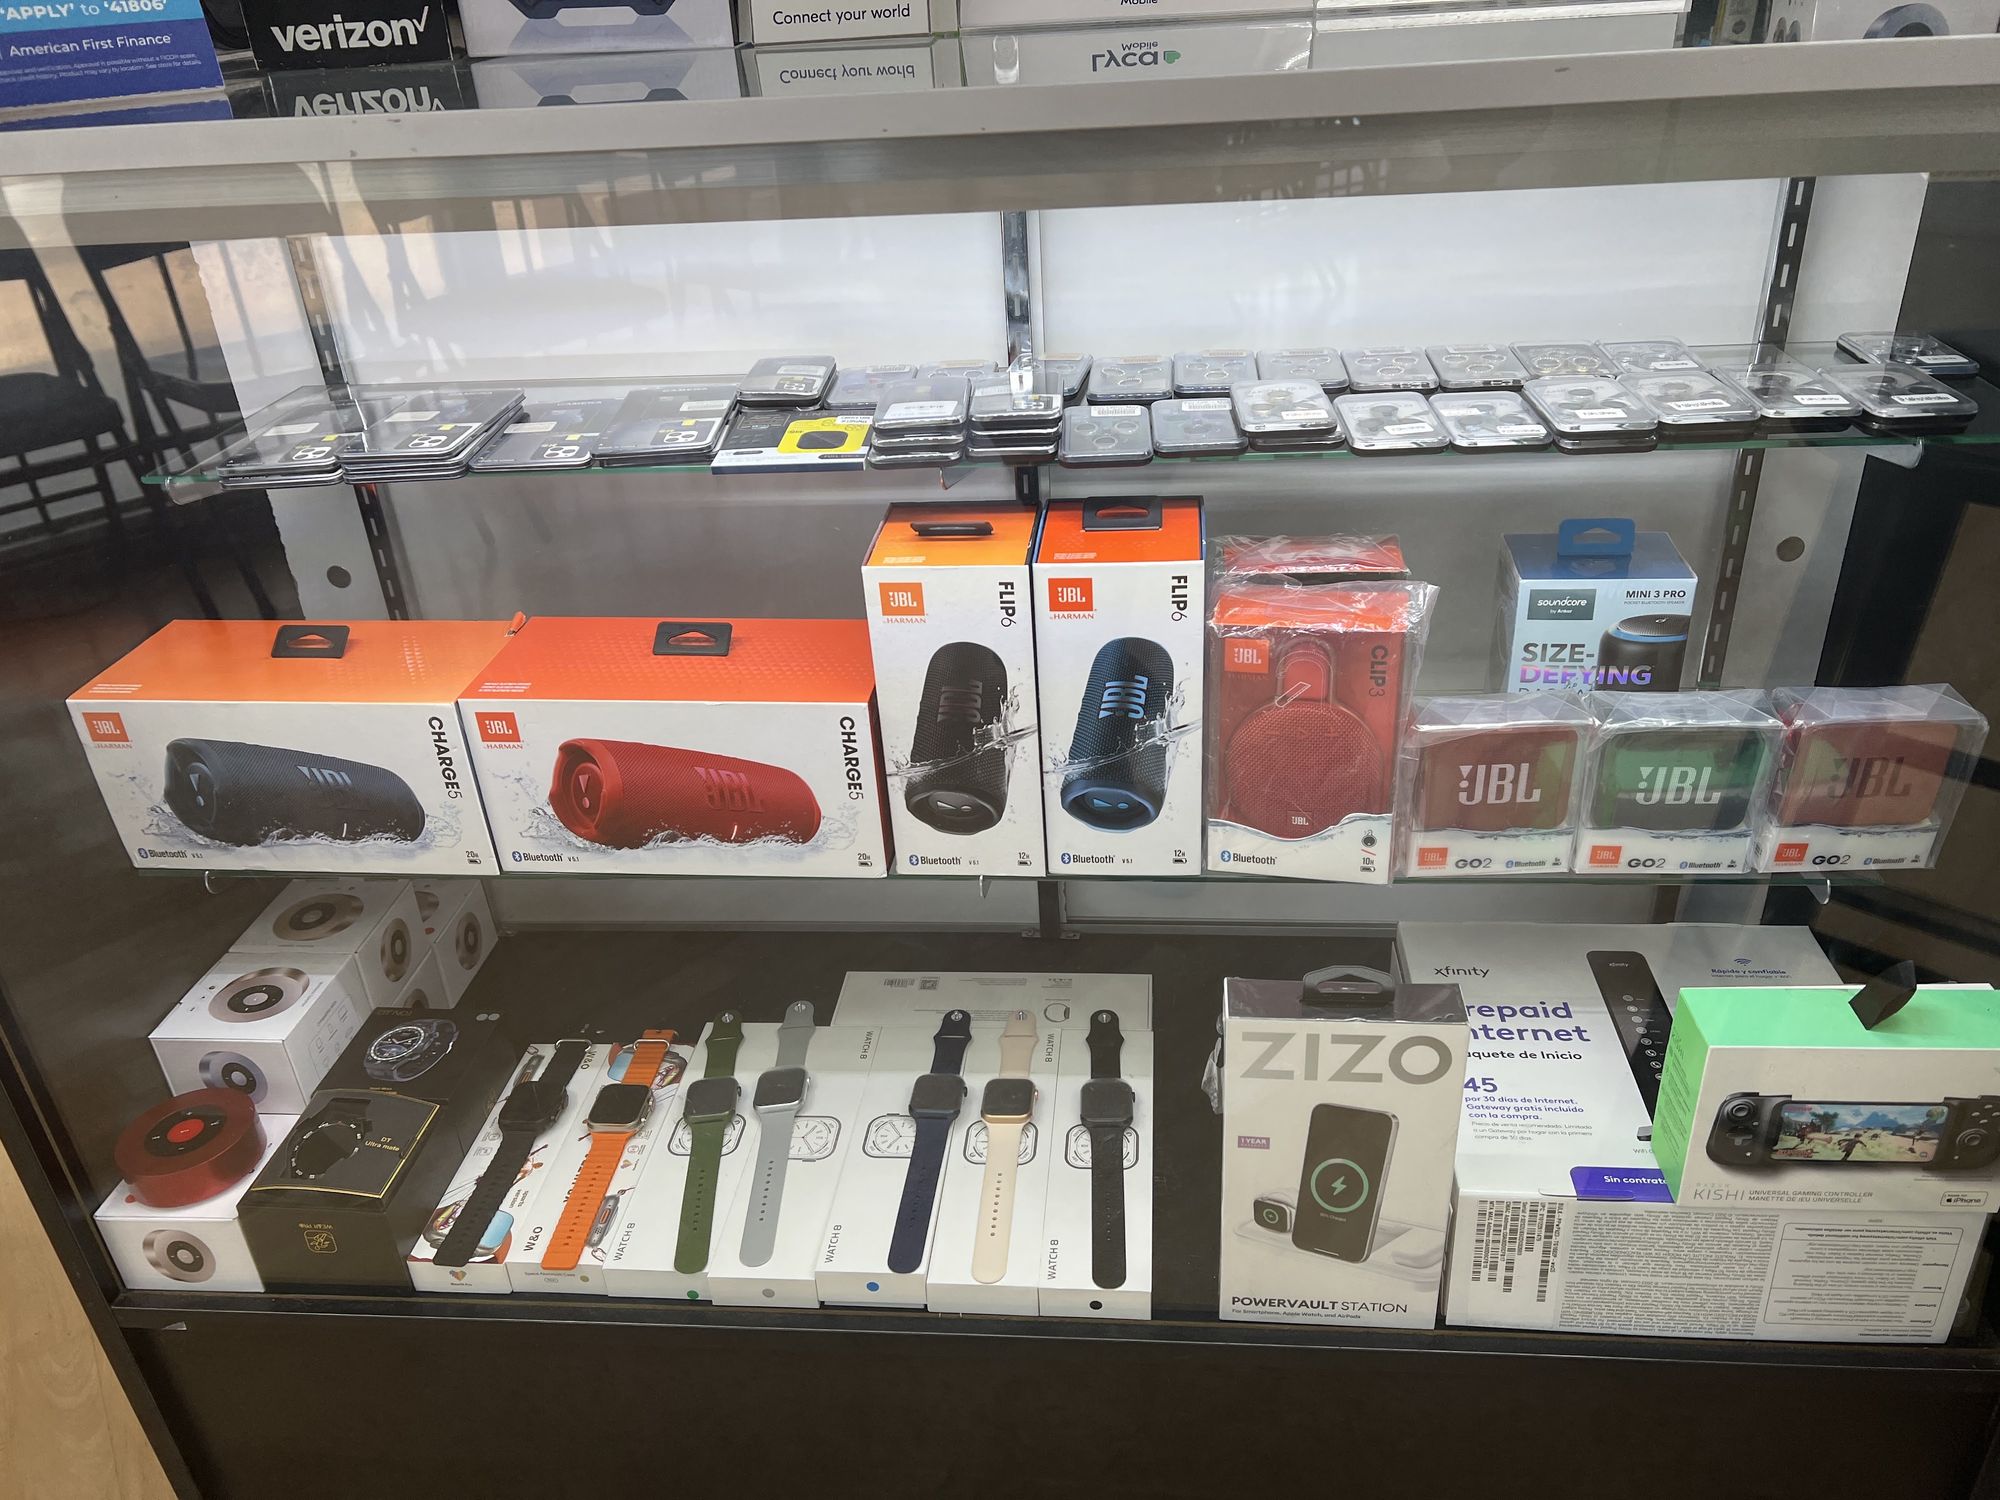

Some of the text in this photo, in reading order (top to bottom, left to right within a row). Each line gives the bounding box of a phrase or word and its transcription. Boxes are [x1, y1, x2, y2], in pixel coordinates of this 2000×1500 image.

[80, 4, 100, 15] to
[773, 4, 911, 25] Connect your world
[270, 15, 419, 52] verizon
[10, 34, 171, 57] American First Finance
[888, 592, 917, 608] JBL
[1058, 587, 1086, 603] JBL
[1537, 596, 1588, 607] soundcore
[1625, 590, 1686, 598] MINI 3 PRO
[1234, 648, 1262, 664] JBL
[1521, 643, 1595, 663] SIZE-
[1520, 665, 1653, 685] DEFYING
[1099, 674, 1149, 720] JBL
[92, 721, 121, 734] JBL
[485, 721, 513, 734] JBL
[696, 767, 764, 813] JBL
[1459, 763, 1541, 805] JBL
[1636, 766, 1721, 805] JBL
[1292, 817, 1309, 826] JBL
[148, 849, 187, 858] Bluetooth
[523, 852, 563, 862] Bluetooth
[921, 856, 961, 865] Bluetooth
[1072, 854, 1114, 863] Bluetooth
[1232, 852, 1277, 865] Bluetooth
[1435, 965, 1490, 979] xfinity
[1466, 1001, 1573, 1022] repaid
[863, 1031, 873, 1053] WATCH
[1046, 1033, 1055, 1054] WATCH
[1239, 1031, 1453, 1085] ZIZO
[1519, 1050, 1537, 1059] de
[1541, 1051, 1582, 1060] Inicio
[1466, 1103, 1584, 1113] Gateway gratis incluido
[365, 1140, 382, 1148] Ultra
[1693, 1189, 1745, 1200] KISHI
[614, 1231, 632, 1261] WATCH
[825, 1234, 840, 1263] WATCH
[1048, 1248, 1058, 1280] WATCH
[1232, 1296, 1408, 1313] POWERVAULT STATION
